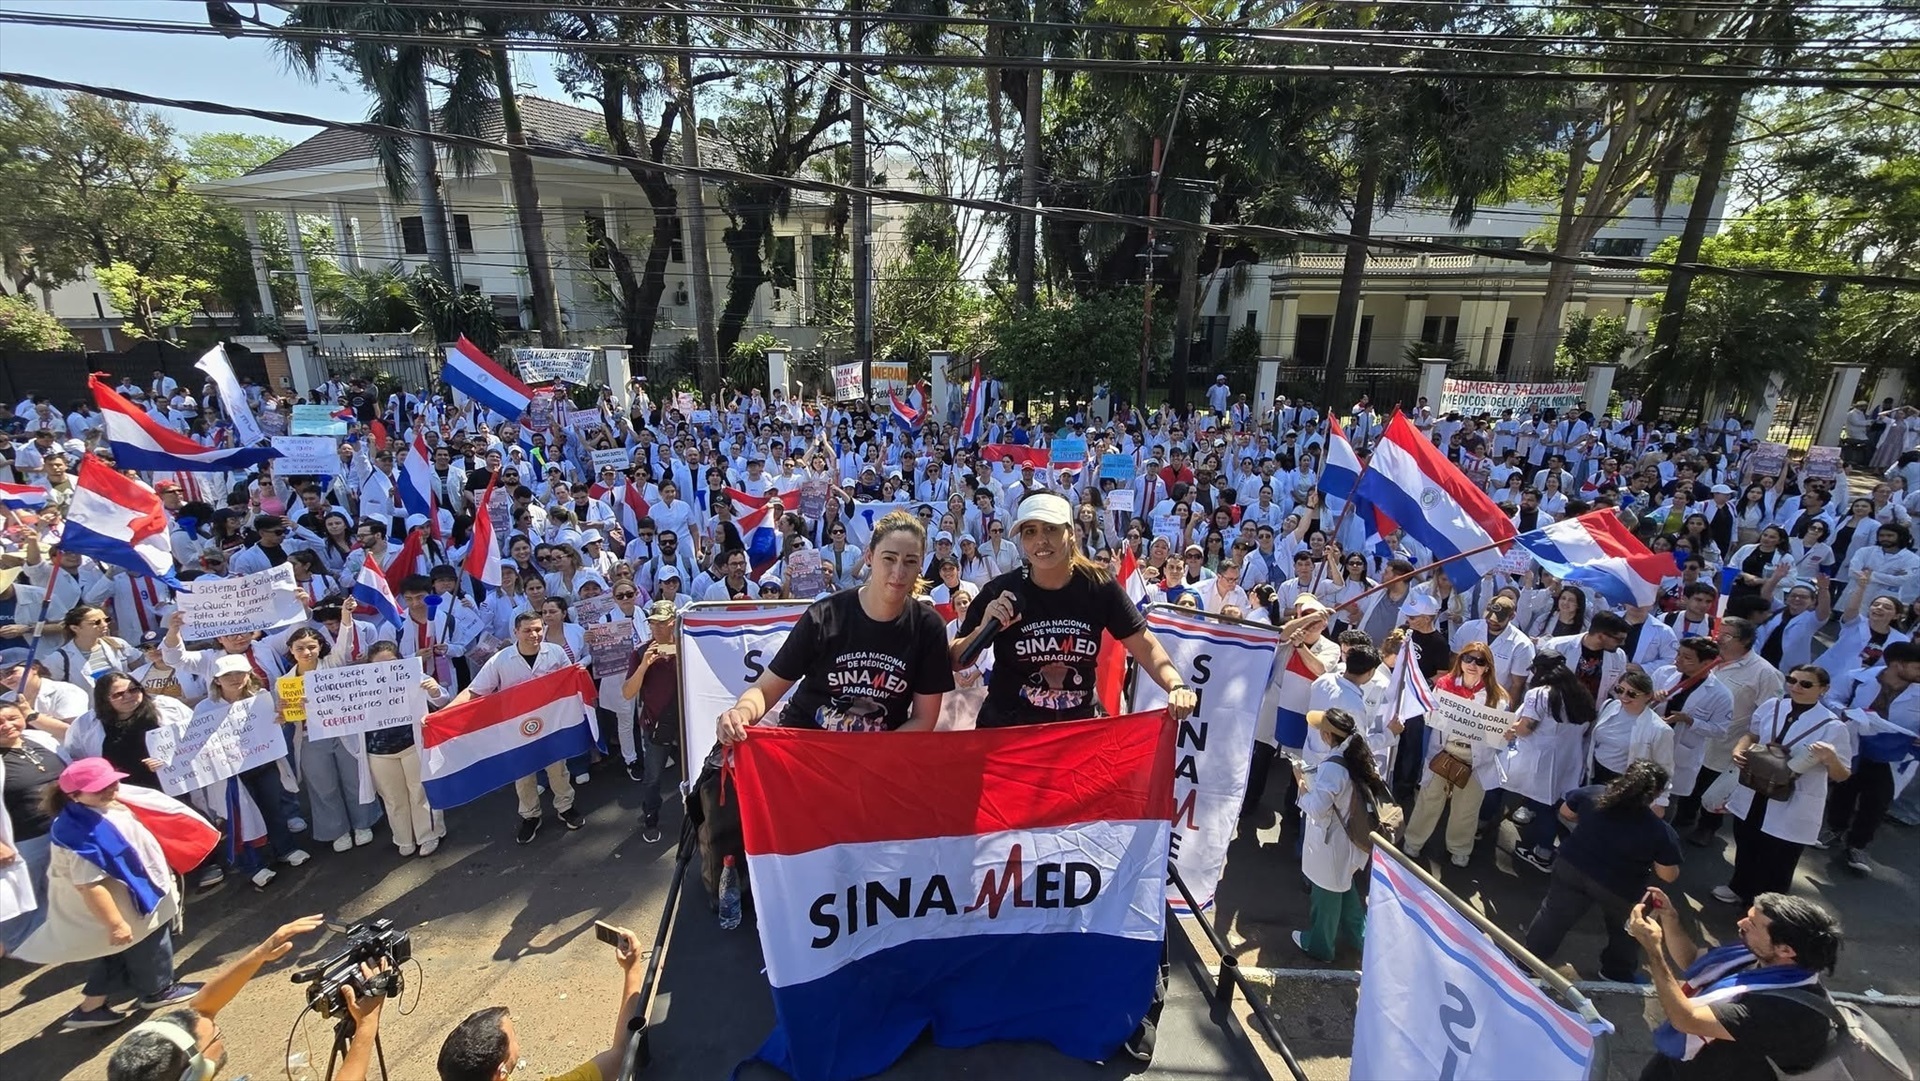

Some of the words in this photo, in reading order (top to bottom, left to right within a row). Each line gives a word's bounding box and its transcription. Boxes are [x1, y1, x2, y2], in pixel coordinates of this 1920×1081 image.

[1513, 383, 1565, 396] SALARIAL
[241, 580, 251, 590] de
[141, 590, 149, 600] 9
[221, 592, 232, 600] de
[236, 588, 257, 598] LUTO
[237, 600, 245, 608] lo
[218, 609, 229, 617] de
[1021, 620, 1051, 633] HUELGA
[1052, 619, 1091, 632] NACIONAL
[1034, 628, 1044, 637] DE
[1046, 626, 1080, 636] MÉDICOS
[1015, 635, 1097, 656] SINAMED
[835, 651, 867, 664] HUELGA
[868, 652, 907, 671] NACIONAL
[847, 660, 859, 669] DE
[860, 659, 894, 672] MÉDICOS
[1031, 654, 1083, 663] PARAGUAY
[314, 673, 334, 683] Para
[340, 668, 365, 678] sacar
[390, 663, 404, 671] los
[314, 677, 368, 693] delincuentes
[376, 675, 387, 684] de
[395, 672, 410, 682] las
[827, 669, 908, 693] SINAMED
[349, 689, 382, 702] primero
[389, 684, 406, 695] hay
[842, 686, 890, 699] PARAGUAY
[317, 708, 334, 718] que
[340, 700, 382, 713] sacarlos
[388, 695, 405, 706] del
[1440, 696, 1472, 715] RESPETO
[1472, 710, 1509, 725] LABORAL
[323, 713, 366, 727] GOBIERNO
[1444, 710, 1476, 728] SALARIO
[1477, 723, 1504, 734] DIGNO
[809, 843, 1102, 949] SINAMED
